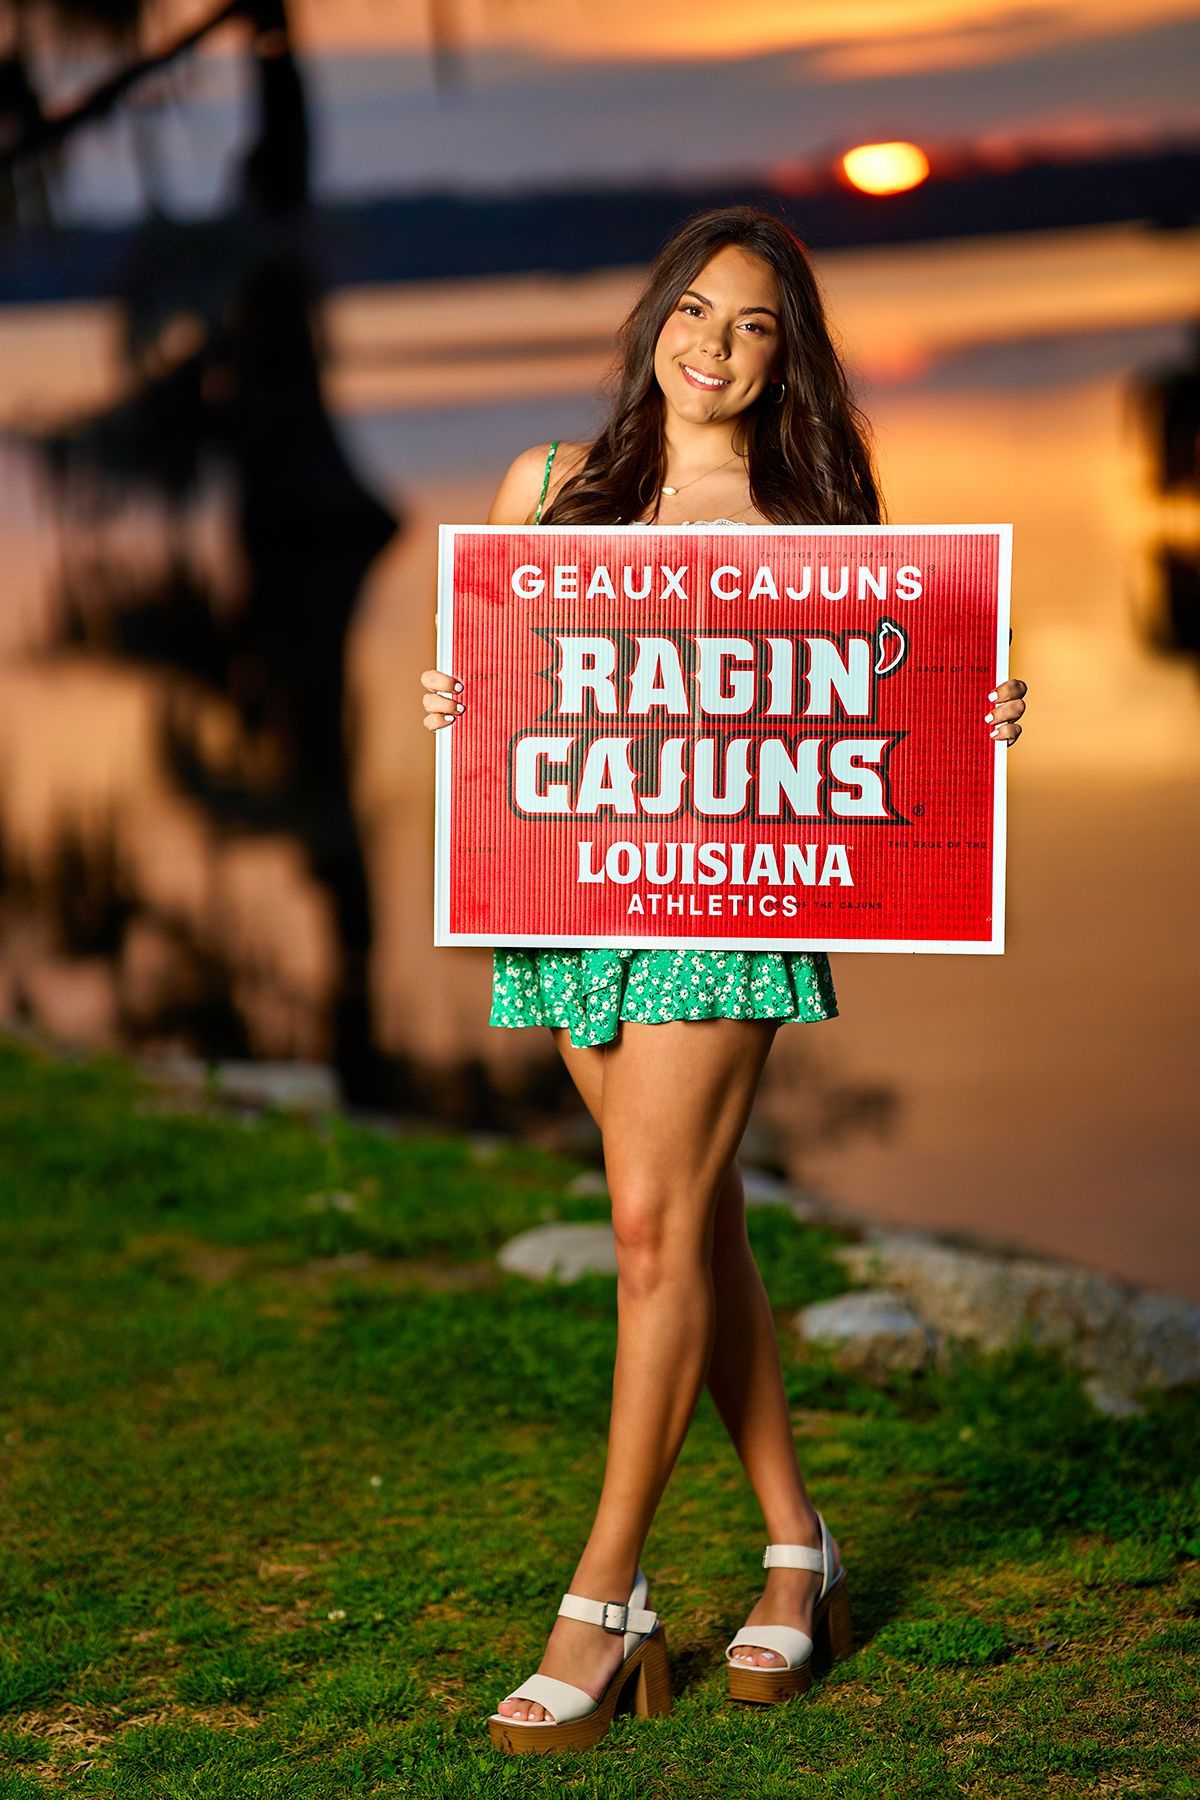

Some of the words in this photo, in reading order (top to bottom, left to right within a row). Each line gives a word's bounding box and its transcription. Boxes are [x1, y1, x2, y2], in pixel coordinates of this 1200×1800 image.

[511, 564, 688, 601] GEAUX
[711, 564, 924, 602] CAJUNS
[950, 665, 964, 674] OF
[515, 737, 891, 817] CAJUNS
[888, 840, 909, 849] THE
[913, 840, 942, 849] RAGE
[947, 840, 961, 849] OF
[966, 840, 987, 849] THE
[577, 841, 855, 887] LOUISIANA
[627, 893, 798, 917] ATHLETICS
[813, 901, 833, 910] THE
[839, 901, 883, 910] CAJUNS
